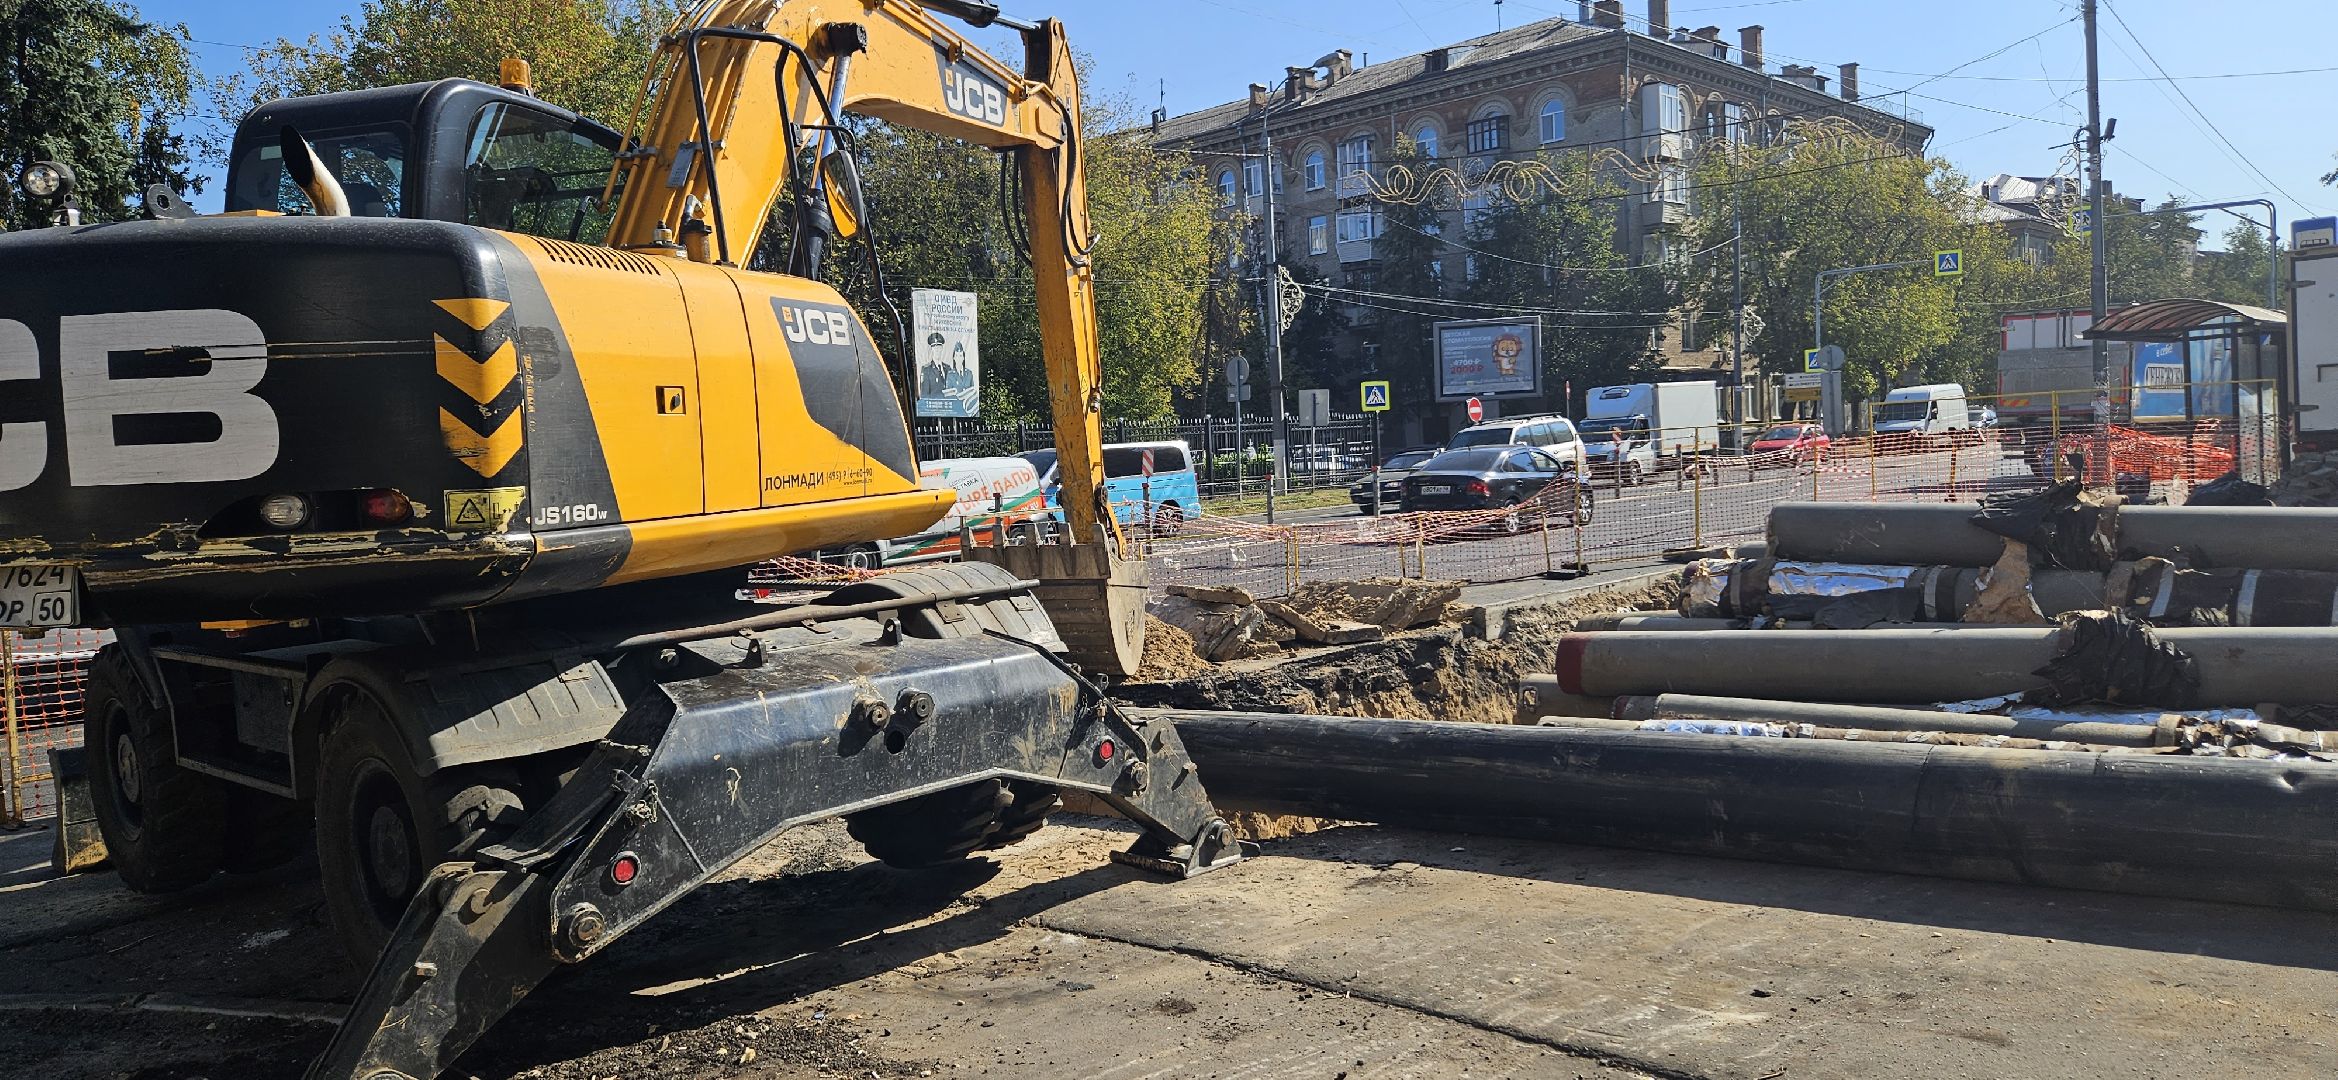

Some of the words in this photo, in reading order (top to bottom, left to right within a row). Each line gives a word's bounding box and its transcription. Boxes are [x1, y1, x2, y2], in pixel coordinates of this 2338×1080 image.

[946, 72, 1004, 125] JCB
[931, 304, 963, 315] РОССИИ
[934, 294, 958, 306] ОМВД
[785, 307, 852, 346] JCB
[0, 308, 281, 493] B
[764, 471, 825, 492] ЛОНМАДИ
[38, 596, 65, 622] 50
